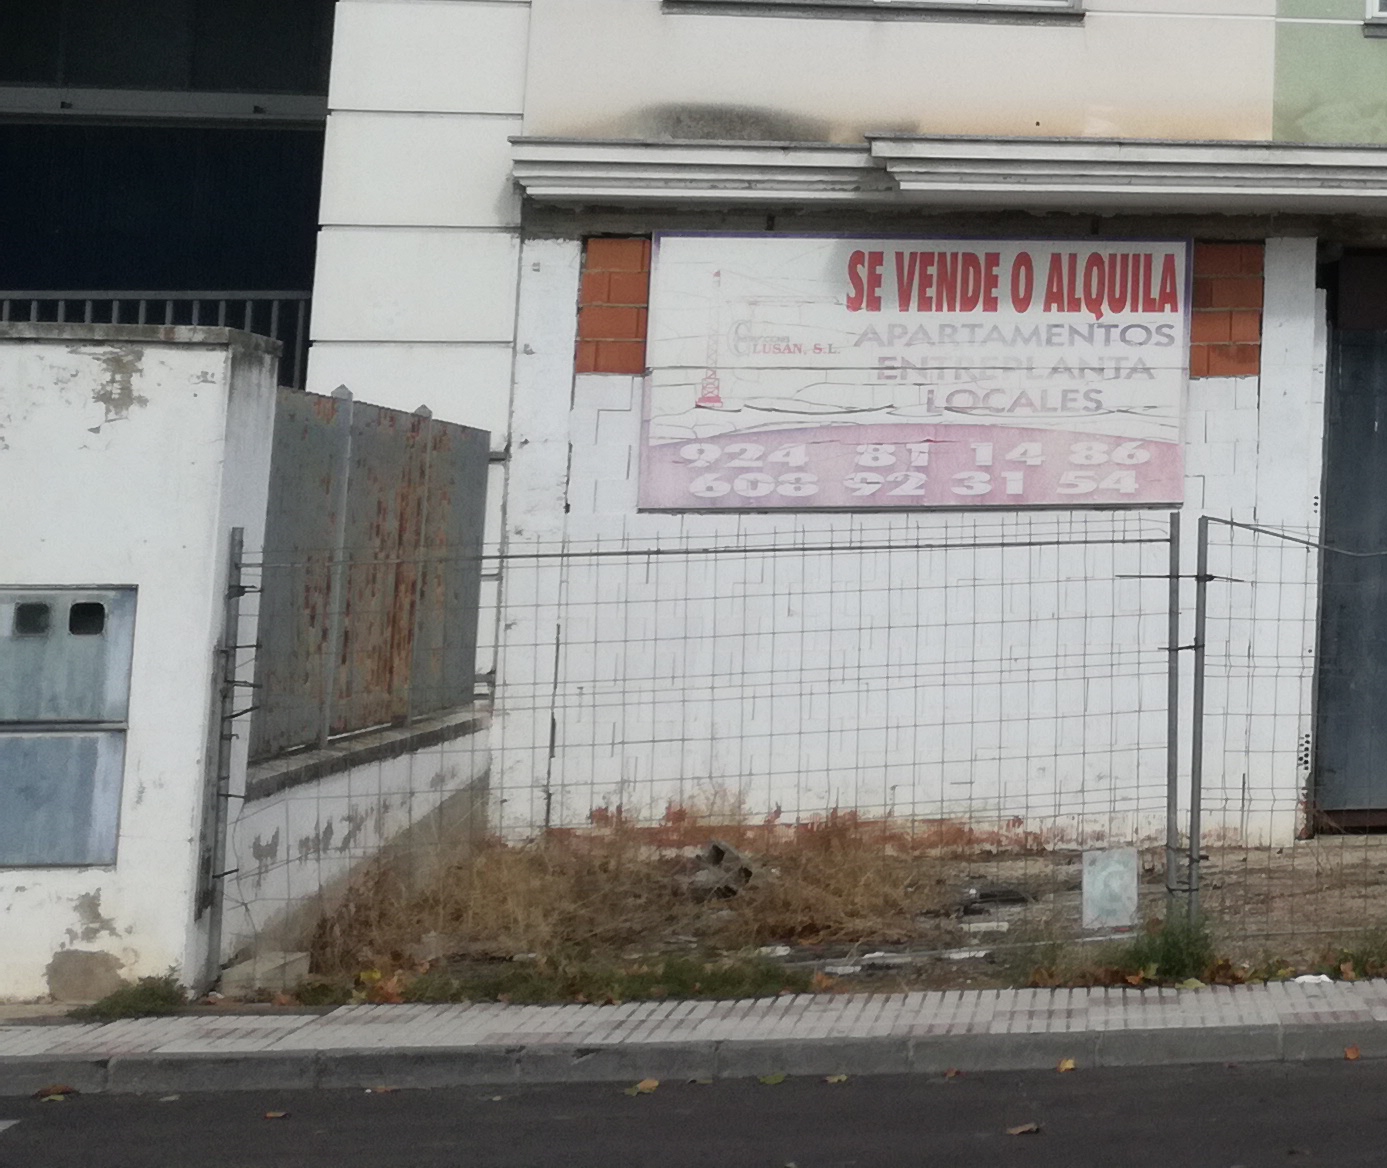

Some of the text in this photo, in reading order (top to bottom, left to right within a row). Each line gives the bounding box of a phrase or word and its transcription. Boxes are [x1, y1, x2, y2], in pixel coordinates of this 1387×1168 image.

[846, 250, 1179, 320] SE VENDE O ALQUILA
[854, 323, 1175, 347] APARTAMENTOS
[877, 356, 1156, 381] ENTREPLANTA
[926, 389, 1103, 414] LOCALES
[679, 441, 1151, 468] 924 81 14 86
[688, 470, 1140, 498] 608 92 31 54
